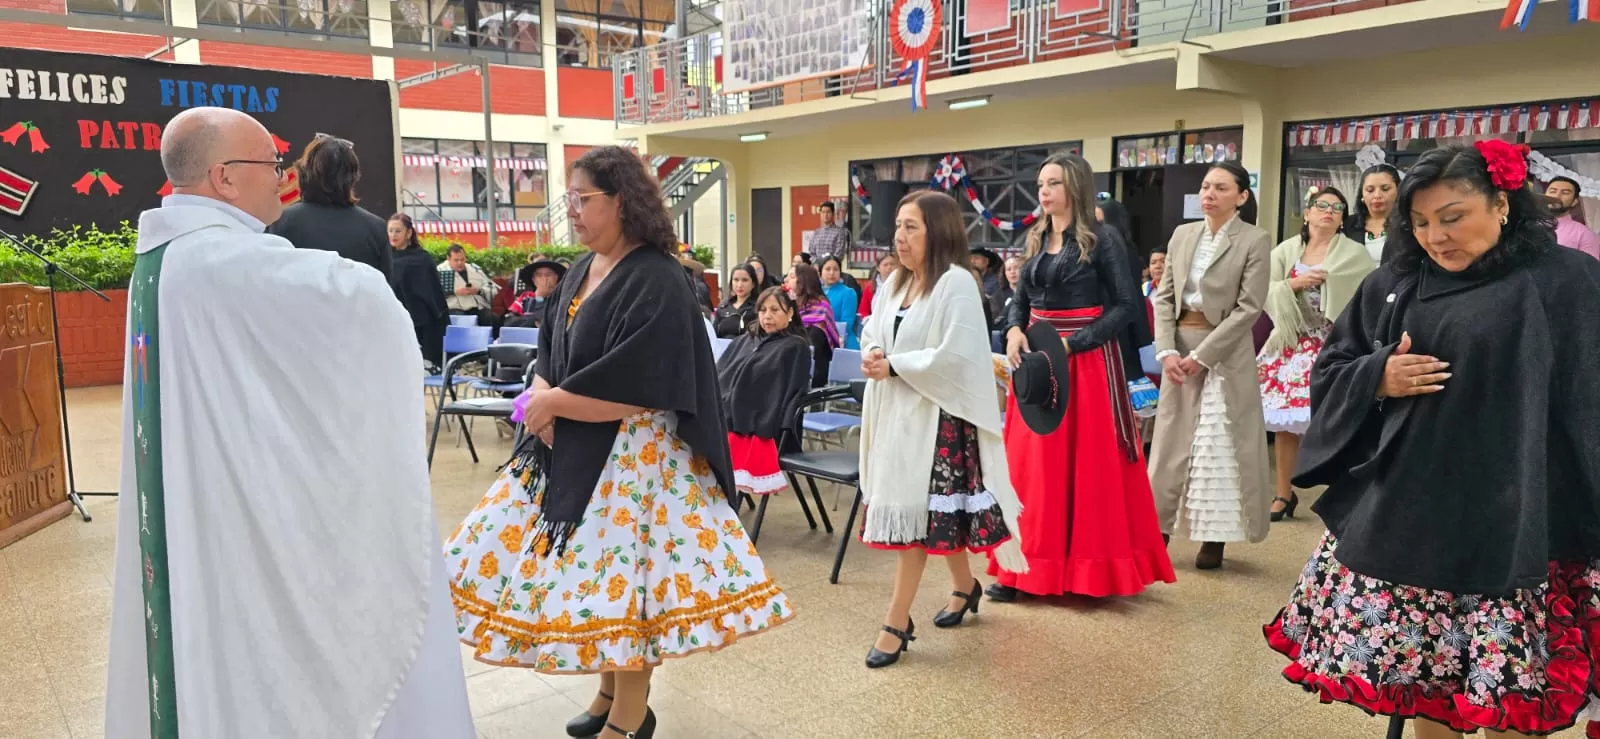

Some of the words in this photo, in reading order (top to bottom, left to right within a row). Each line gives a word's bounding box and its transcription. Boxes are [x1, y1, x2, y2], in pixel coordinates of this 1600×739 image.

[0, 68, 127, 105] FELICES
[159, 79, 279, 113] FIESTAS
[77, 119, 161, 151] PATR
